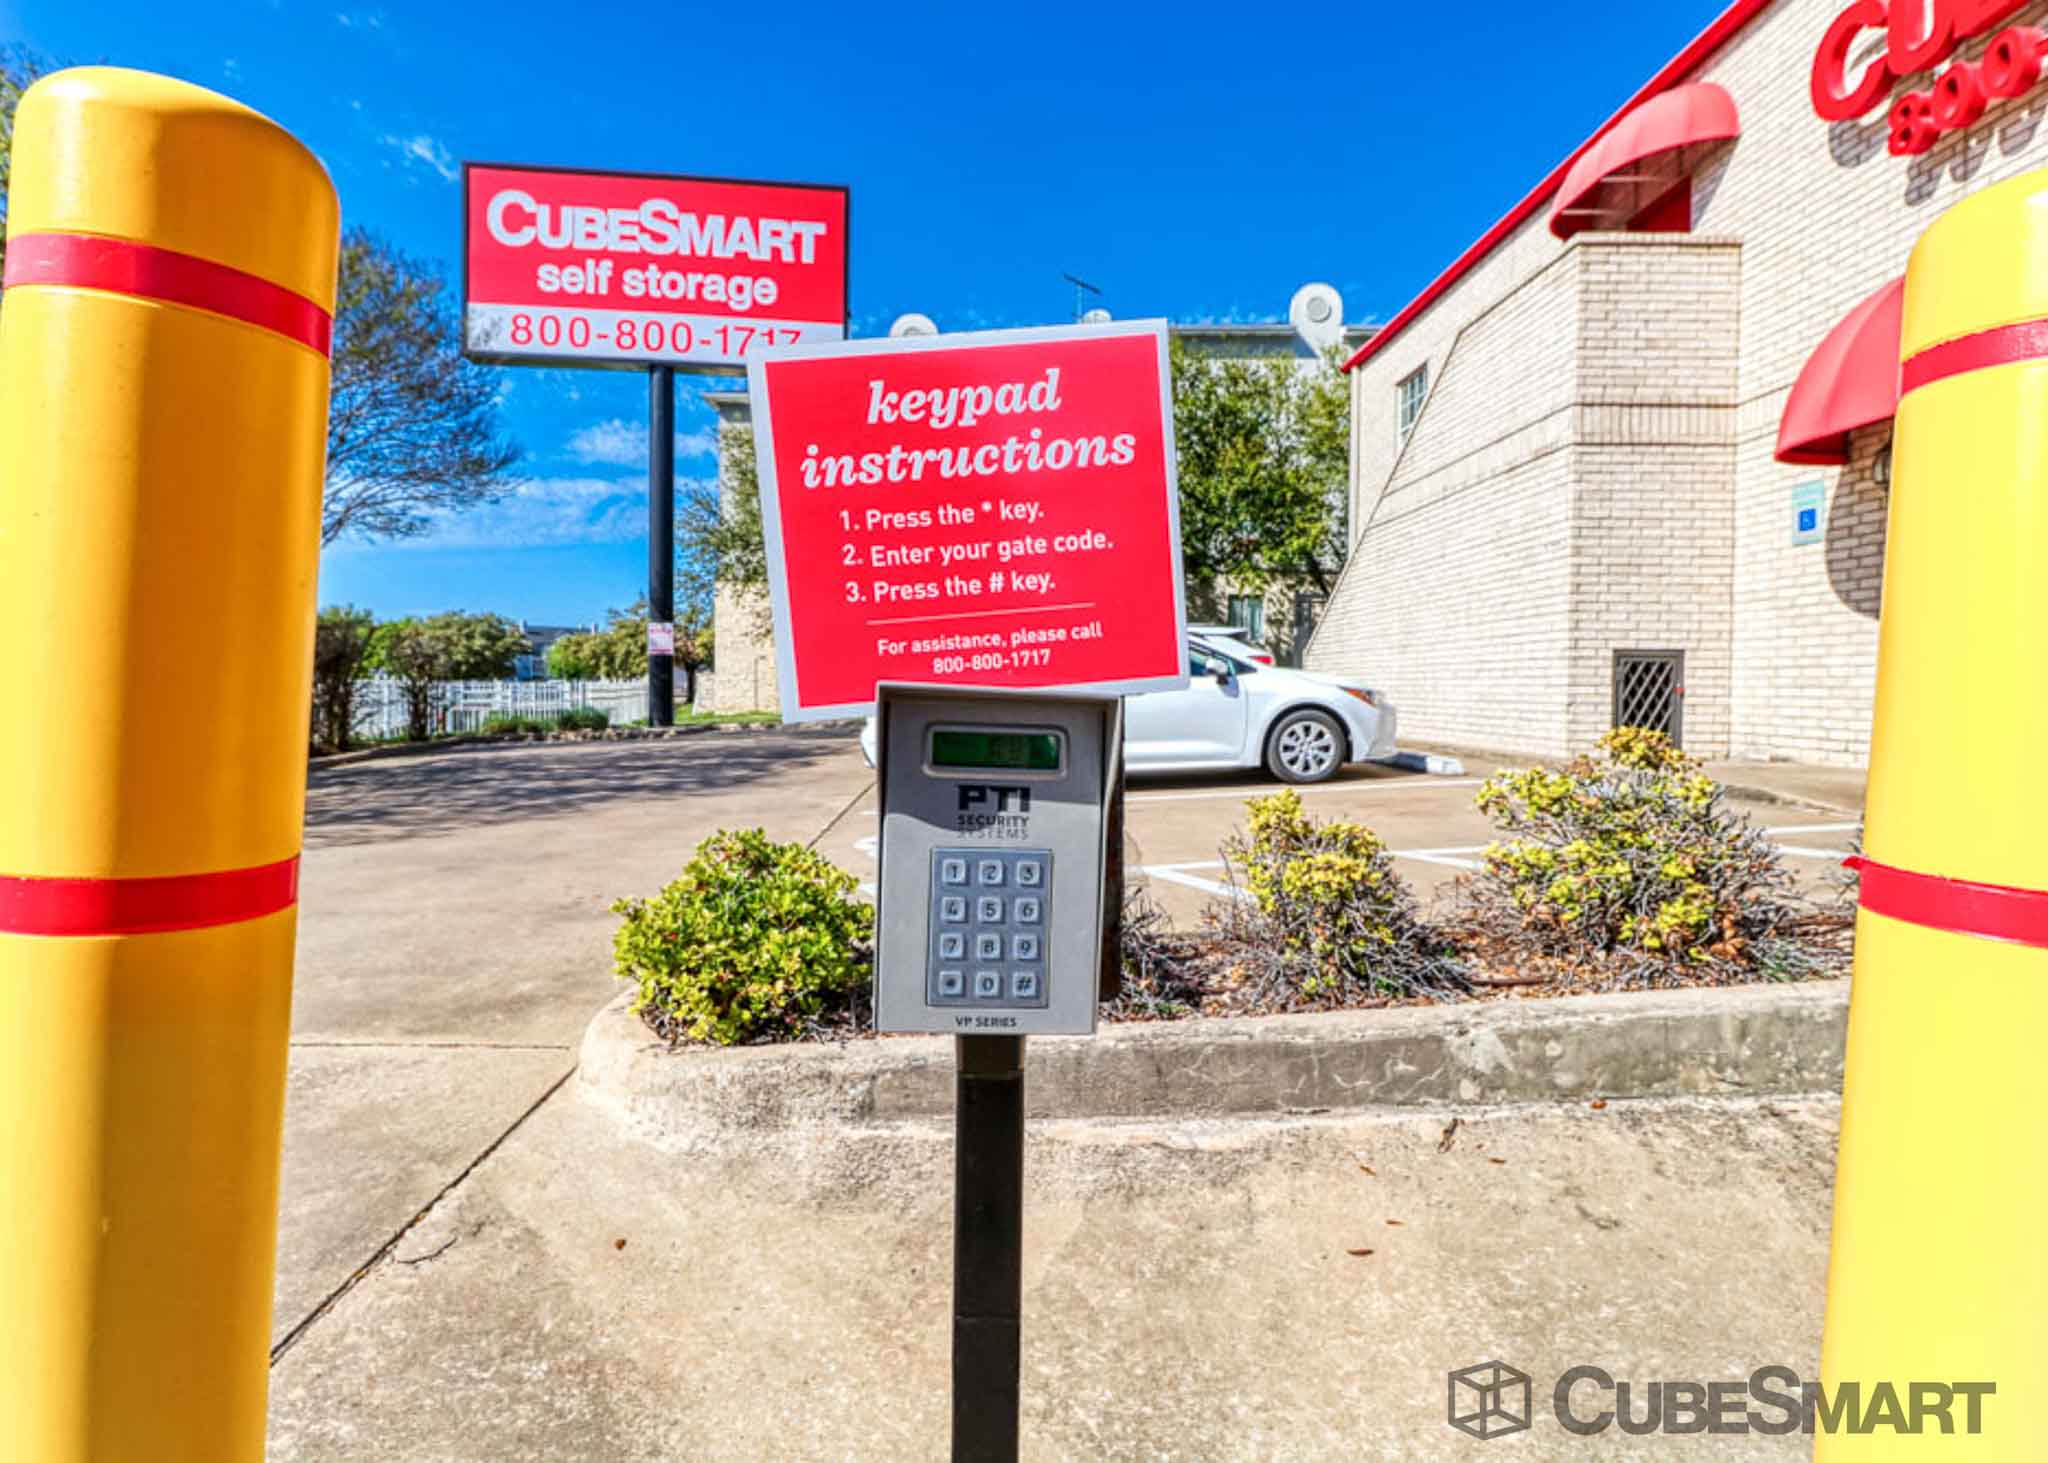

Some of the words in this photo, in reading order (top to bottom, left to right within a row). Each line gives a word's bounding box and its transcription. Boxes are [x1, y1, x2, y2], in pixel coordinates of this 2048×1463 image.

[486, 189, 827, 265] CUBESMART
[536, 259, 614, 295] self
[622, 264, 778, 312] storage
[867, 368, 1062, 429] keypad
[799, 427, 1137, 489] instructions
[839, 509, 860, 532] 1.
[865, 507, 932, 531] Press
[937, 504, 975, 525] the
[1000, 499, 1045, 524] key.
[842, 544, 864, 566] 2.
[871, 543, 934, 568] Enter
[940, 541, 990, 567] your
[997, 535, 1047, 562] gate
[1053, 528, 1114, 552] code.
[845, 581, 866, 603] 3.
[873, 578, 940, 603] Press
[945, 576, 982, 597] the
[989, 572, 1005, 593] #
[1011, 570, 1056, 595] key.
[877, 637, 907, 656] For
[911, 633, 1007, 653] assistance,
[1010, 627, 1067, 647] please
[1071, 620, 1104, 639] call
[932, 648, 1051, 675] 800-800-1717
[957, 784, 1031, 812] PTI
[957, 814, 1030, 827] SECURITY
[957, 827, 1029, 840] SYSTEMS
[984, 864, 997, 880] 2
[986, 903, 997, 918] 5
[1023, 903, 1035, 918] 6
[984, 940, 995, 955] 8
[982, 977, 994, 991] 0
[1018, 976, 1032, 991] #
[955, 1016, 973, 1027] VP
[975, 1017, 1017, 1029] SERIES
